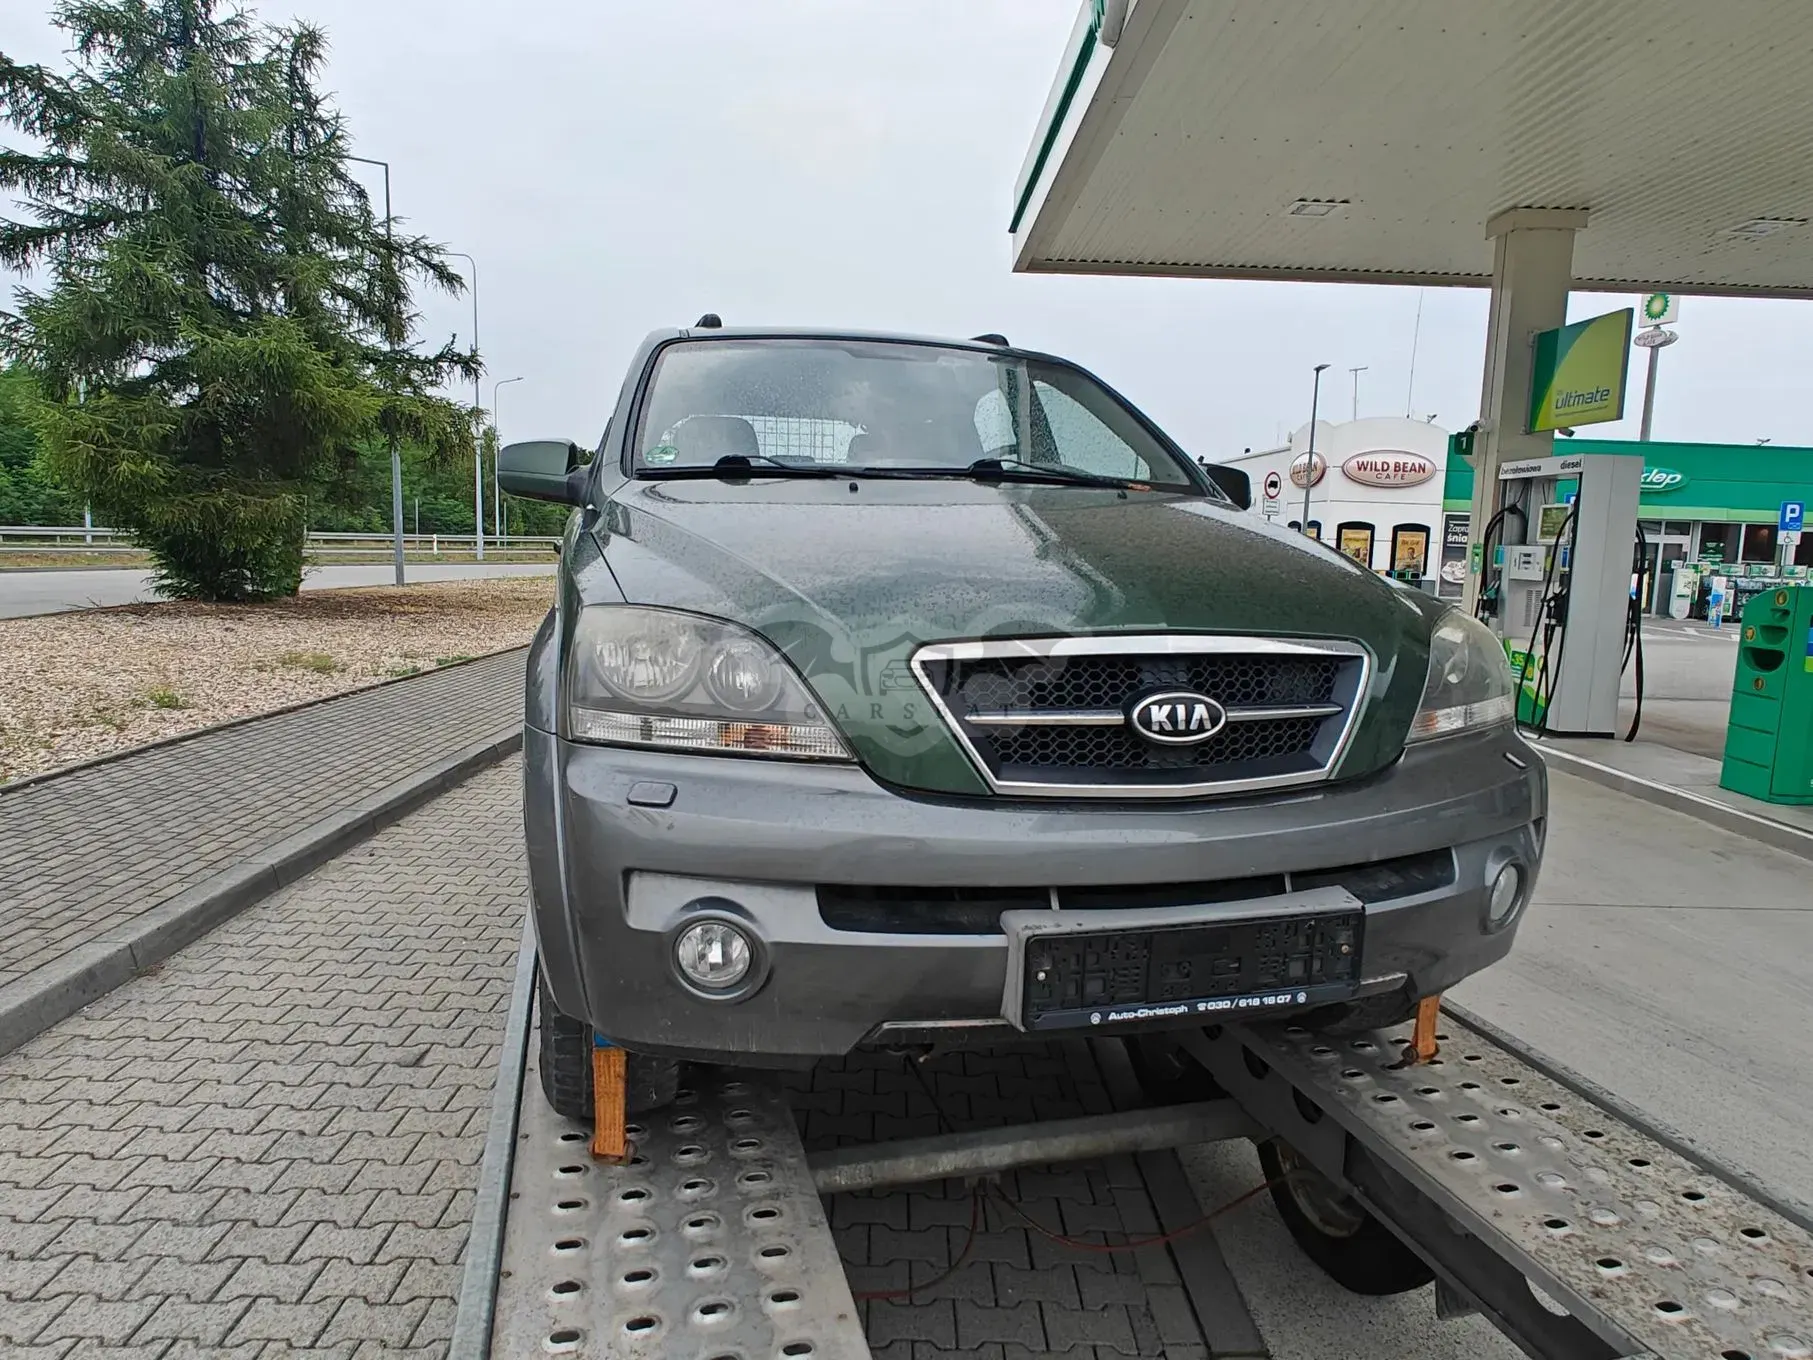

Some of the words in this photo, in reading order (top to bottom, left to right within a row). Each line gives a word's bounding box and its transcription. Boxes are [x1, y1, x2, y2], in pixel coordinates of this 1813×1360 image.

[1555, 385, 1611, 410] ultimate
[1460, 437, 1467, 450] 1
[1356, 460, 1390, 473] WILD
[1393, 461, 1426, 474] BEAN
[1560, 458, 1582, 470] diesel
[1375, 472, 1406, 481] CAFE
[1785, 503, 1800, 523] P
[1149, 703, 1212, 731] KIA
[1108, 1004, 1189, 1021] Auto-Christoph
